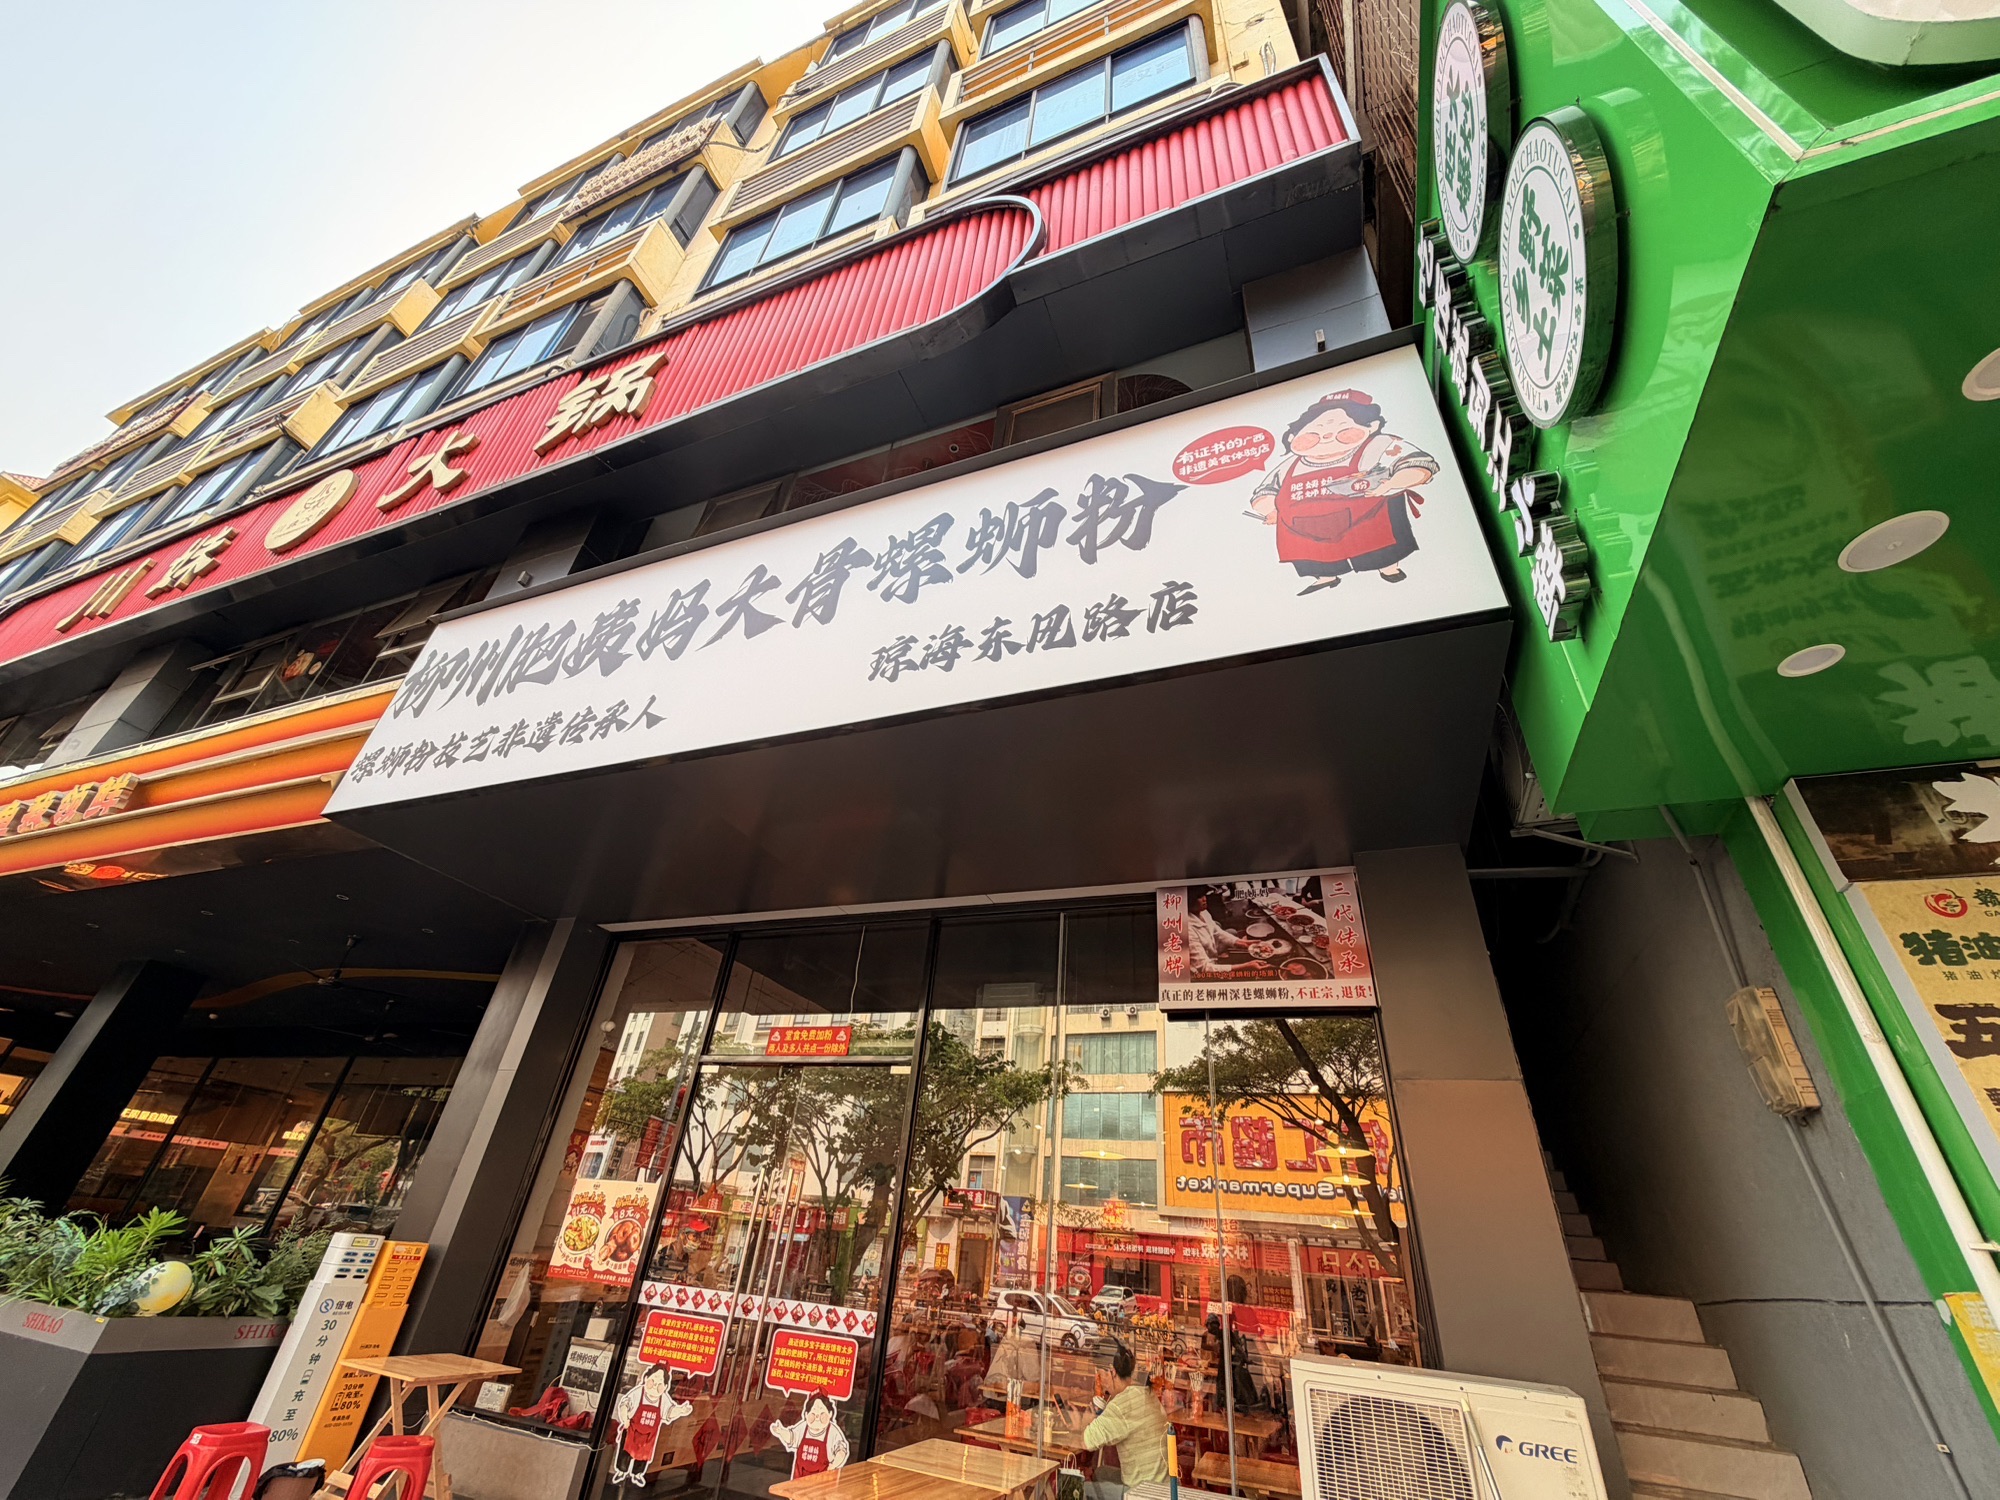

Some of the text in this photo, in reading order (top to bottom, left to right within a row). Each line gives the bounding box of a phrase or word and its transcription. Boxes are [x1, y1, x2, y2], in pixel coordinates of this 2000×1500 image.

[1176, 432, 1265, 465] 有证书的广西
[1417, 222, 1567, 643] 吃饭就到江小鲜
[1179, 443, 1270, 476] 非遗美食体验店
[1353, 479, 1368, 491] 粉
[391, 472, 1189, 720] 柳州肥姨妈大骨螺蛳粉
[867, 579, 1200, 684] 琼海东风路店
[349, 694, 668, 785] 螺蛳粉技艺非遗传承人
[1162, 892, 1185, 978] 柳州老牌
[1328, 881, 1365, 975] 三代传承
[767, 1043, 846, 1054] 两人及多人共点一份除外
[784, 1029, 833, 1041] 堂食免费加粉
[22, 1311, 65, 1335] SHIKAO
[339, 1400, 361, 1410] 80%
[1518, 1441, 1578, 1464] GREE
